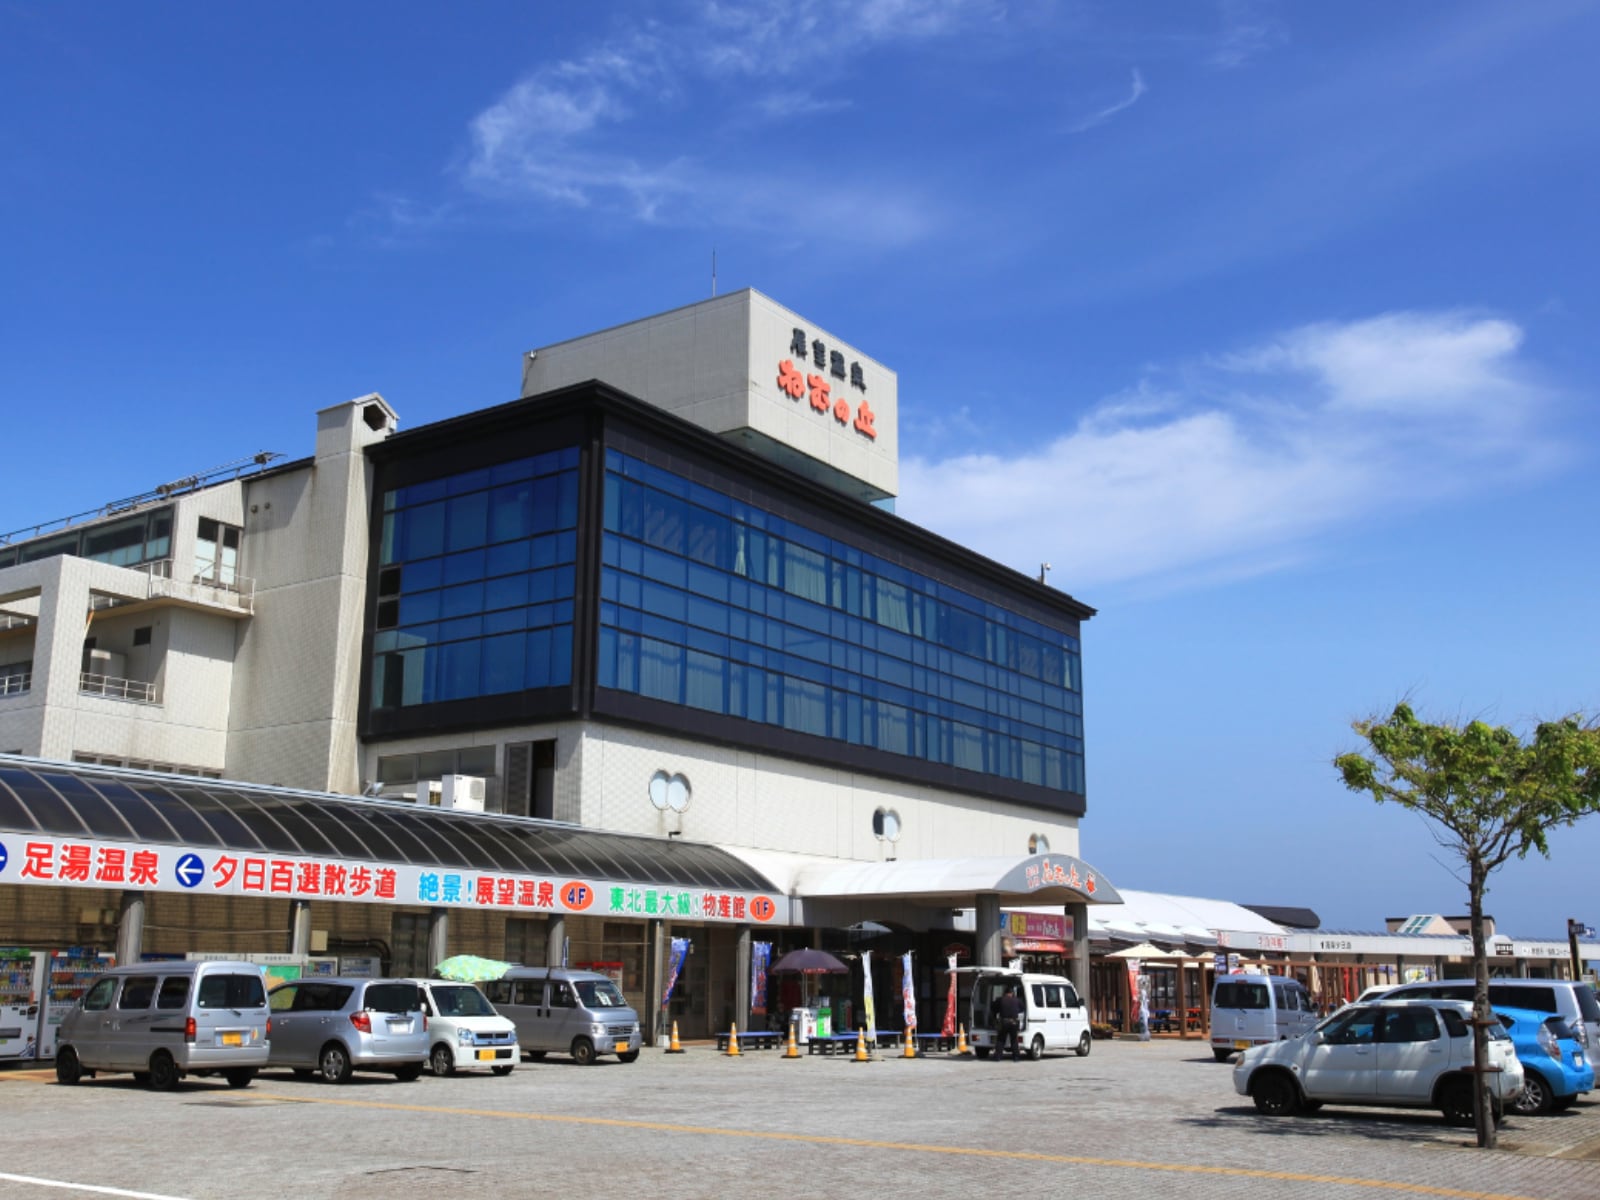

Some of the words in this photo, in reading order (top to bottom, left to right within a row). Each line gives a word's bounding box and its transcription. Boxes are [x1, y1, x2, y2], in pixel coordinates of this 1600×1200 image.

[777, 359, 877, 441] ねむの丘
[21, 841, 160, 885] 足湯温泉
[212, 855, 398, 899] 夕日百選散歩道
[567, 887, 587, 906] 4F
[755, 900, 770, 917] 1F
